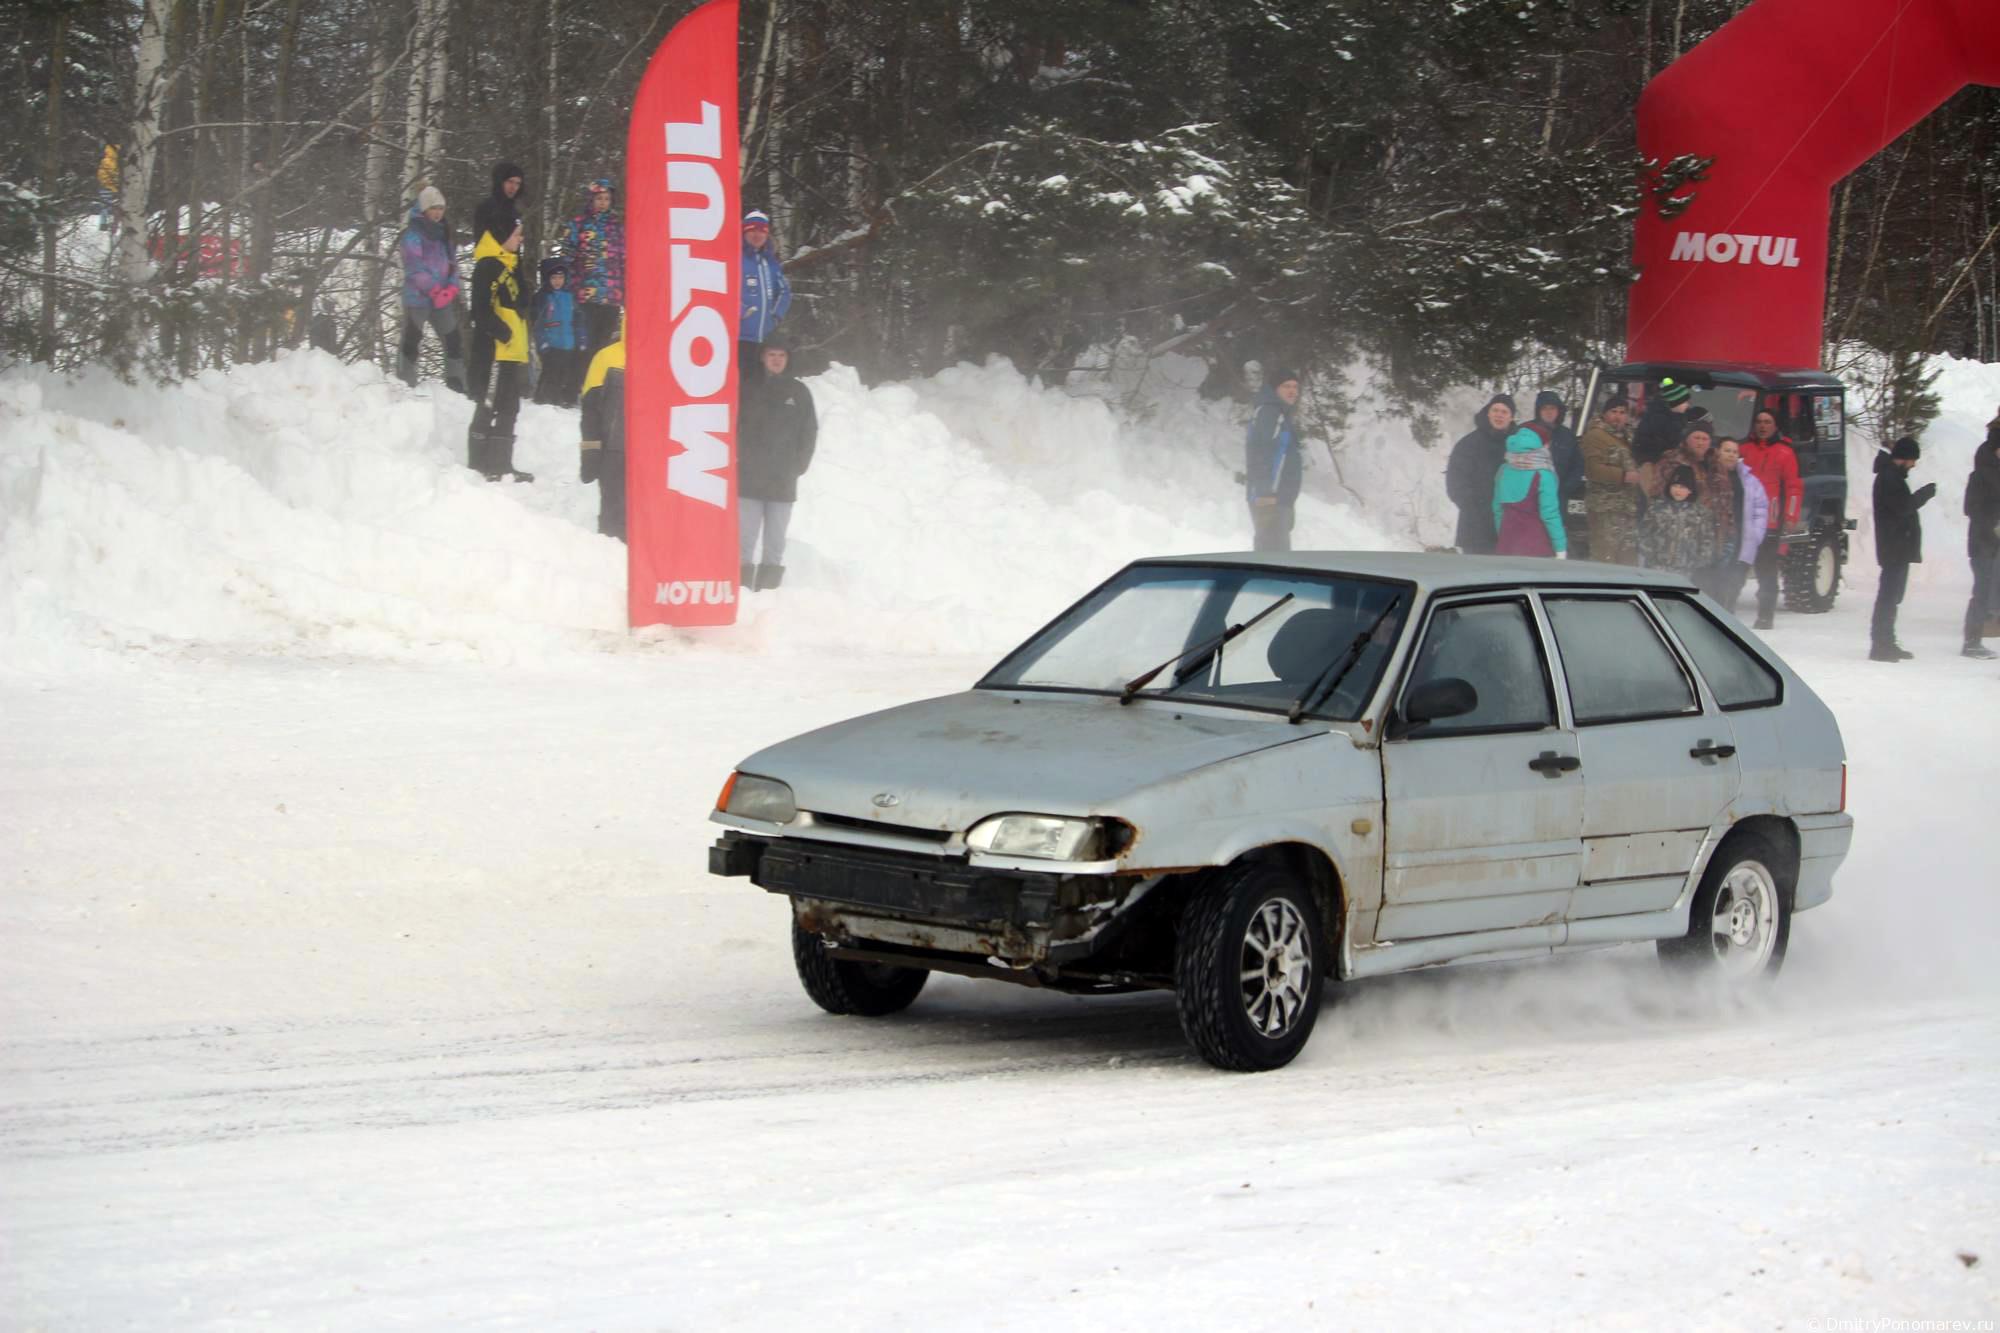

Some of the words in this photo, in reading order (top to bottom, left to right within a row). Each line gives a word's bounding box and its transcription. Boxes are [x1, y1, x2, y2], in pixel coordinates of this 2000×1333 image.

[1669, 231, 1800, 267] MOTUL
[664, 100, 730, 509] MOTUL
[655, 580, 735, 605] MOTUL
